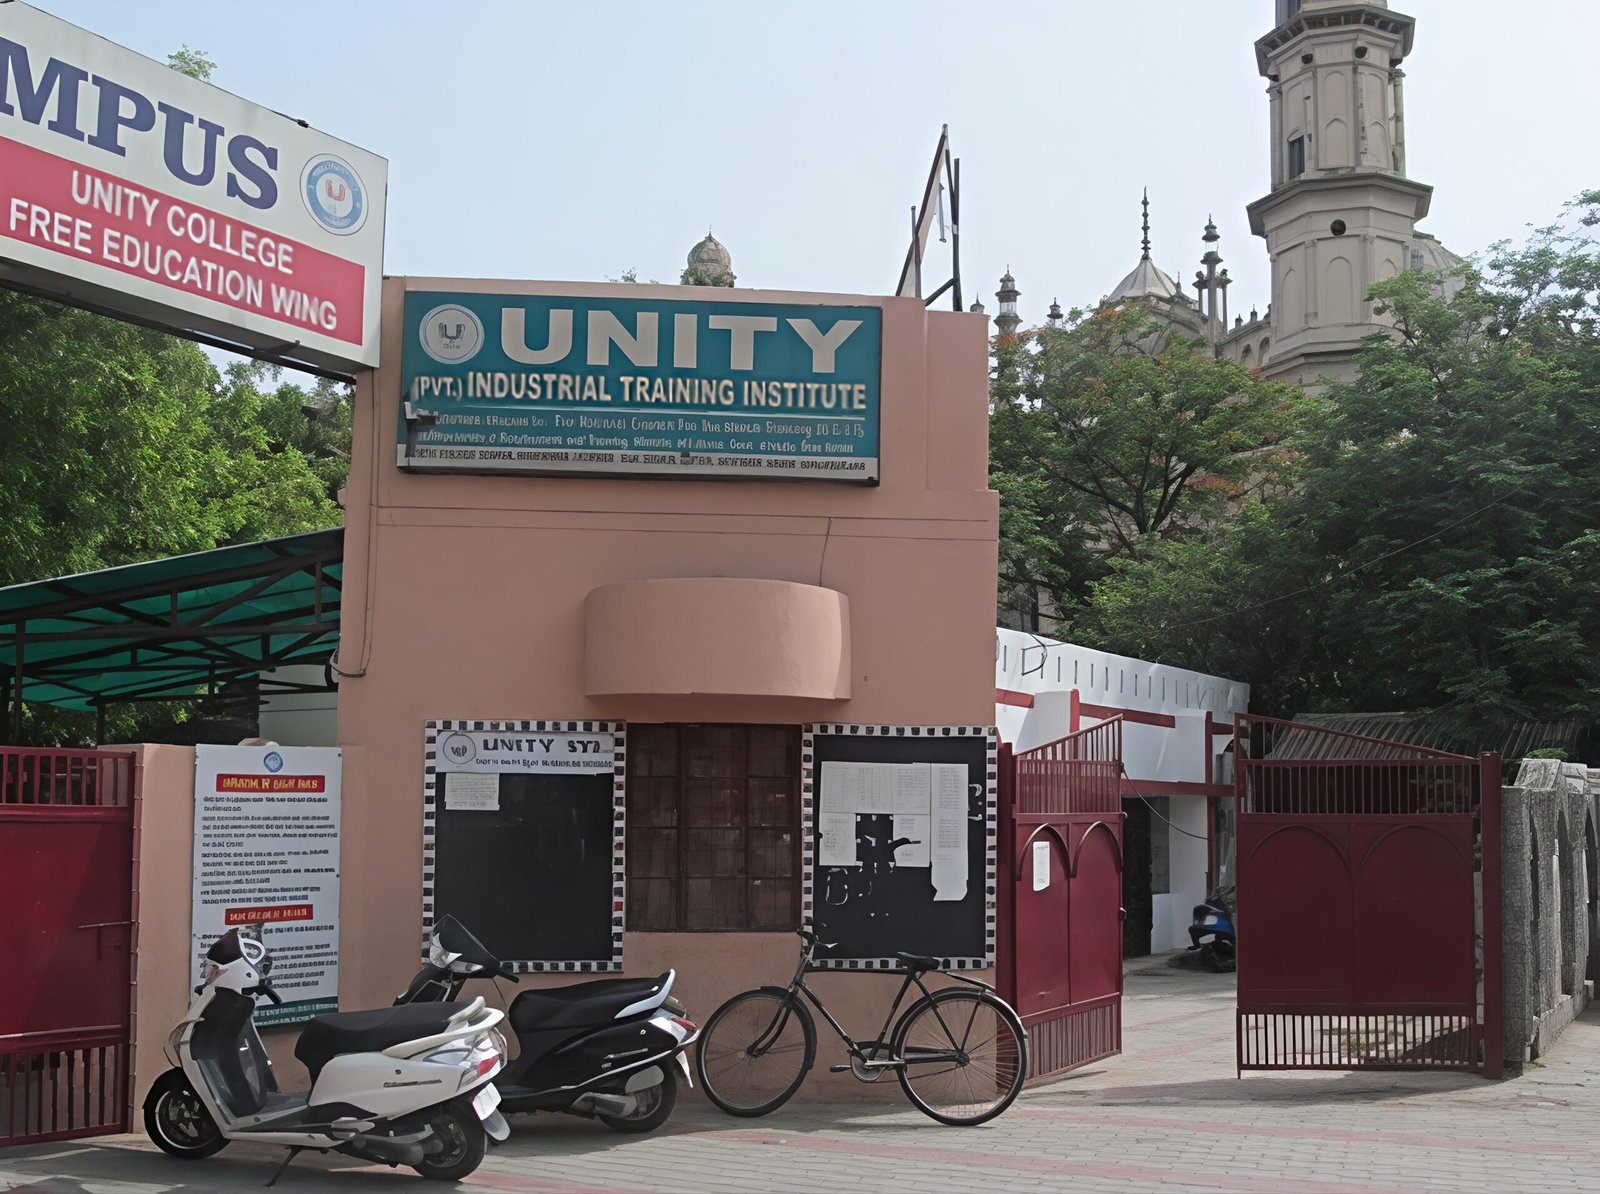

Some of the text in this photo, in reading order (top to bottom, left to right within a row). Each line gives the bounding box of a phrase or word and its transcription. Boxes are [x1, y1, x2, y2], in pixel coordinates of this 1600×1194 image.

[0, 37, 279, 209] MPUS
[10, 197, 338, 331] FREE EDUCATION WING
[72, 170, 294, 275] UNITY COLLEGE
[501, 307, 864, 374] UNITY
[414, 371, 867, 410] (PVT.) INDUSTRIAL TRAINING INSTITUTE
[483, 738, 555, 753] UNITY
